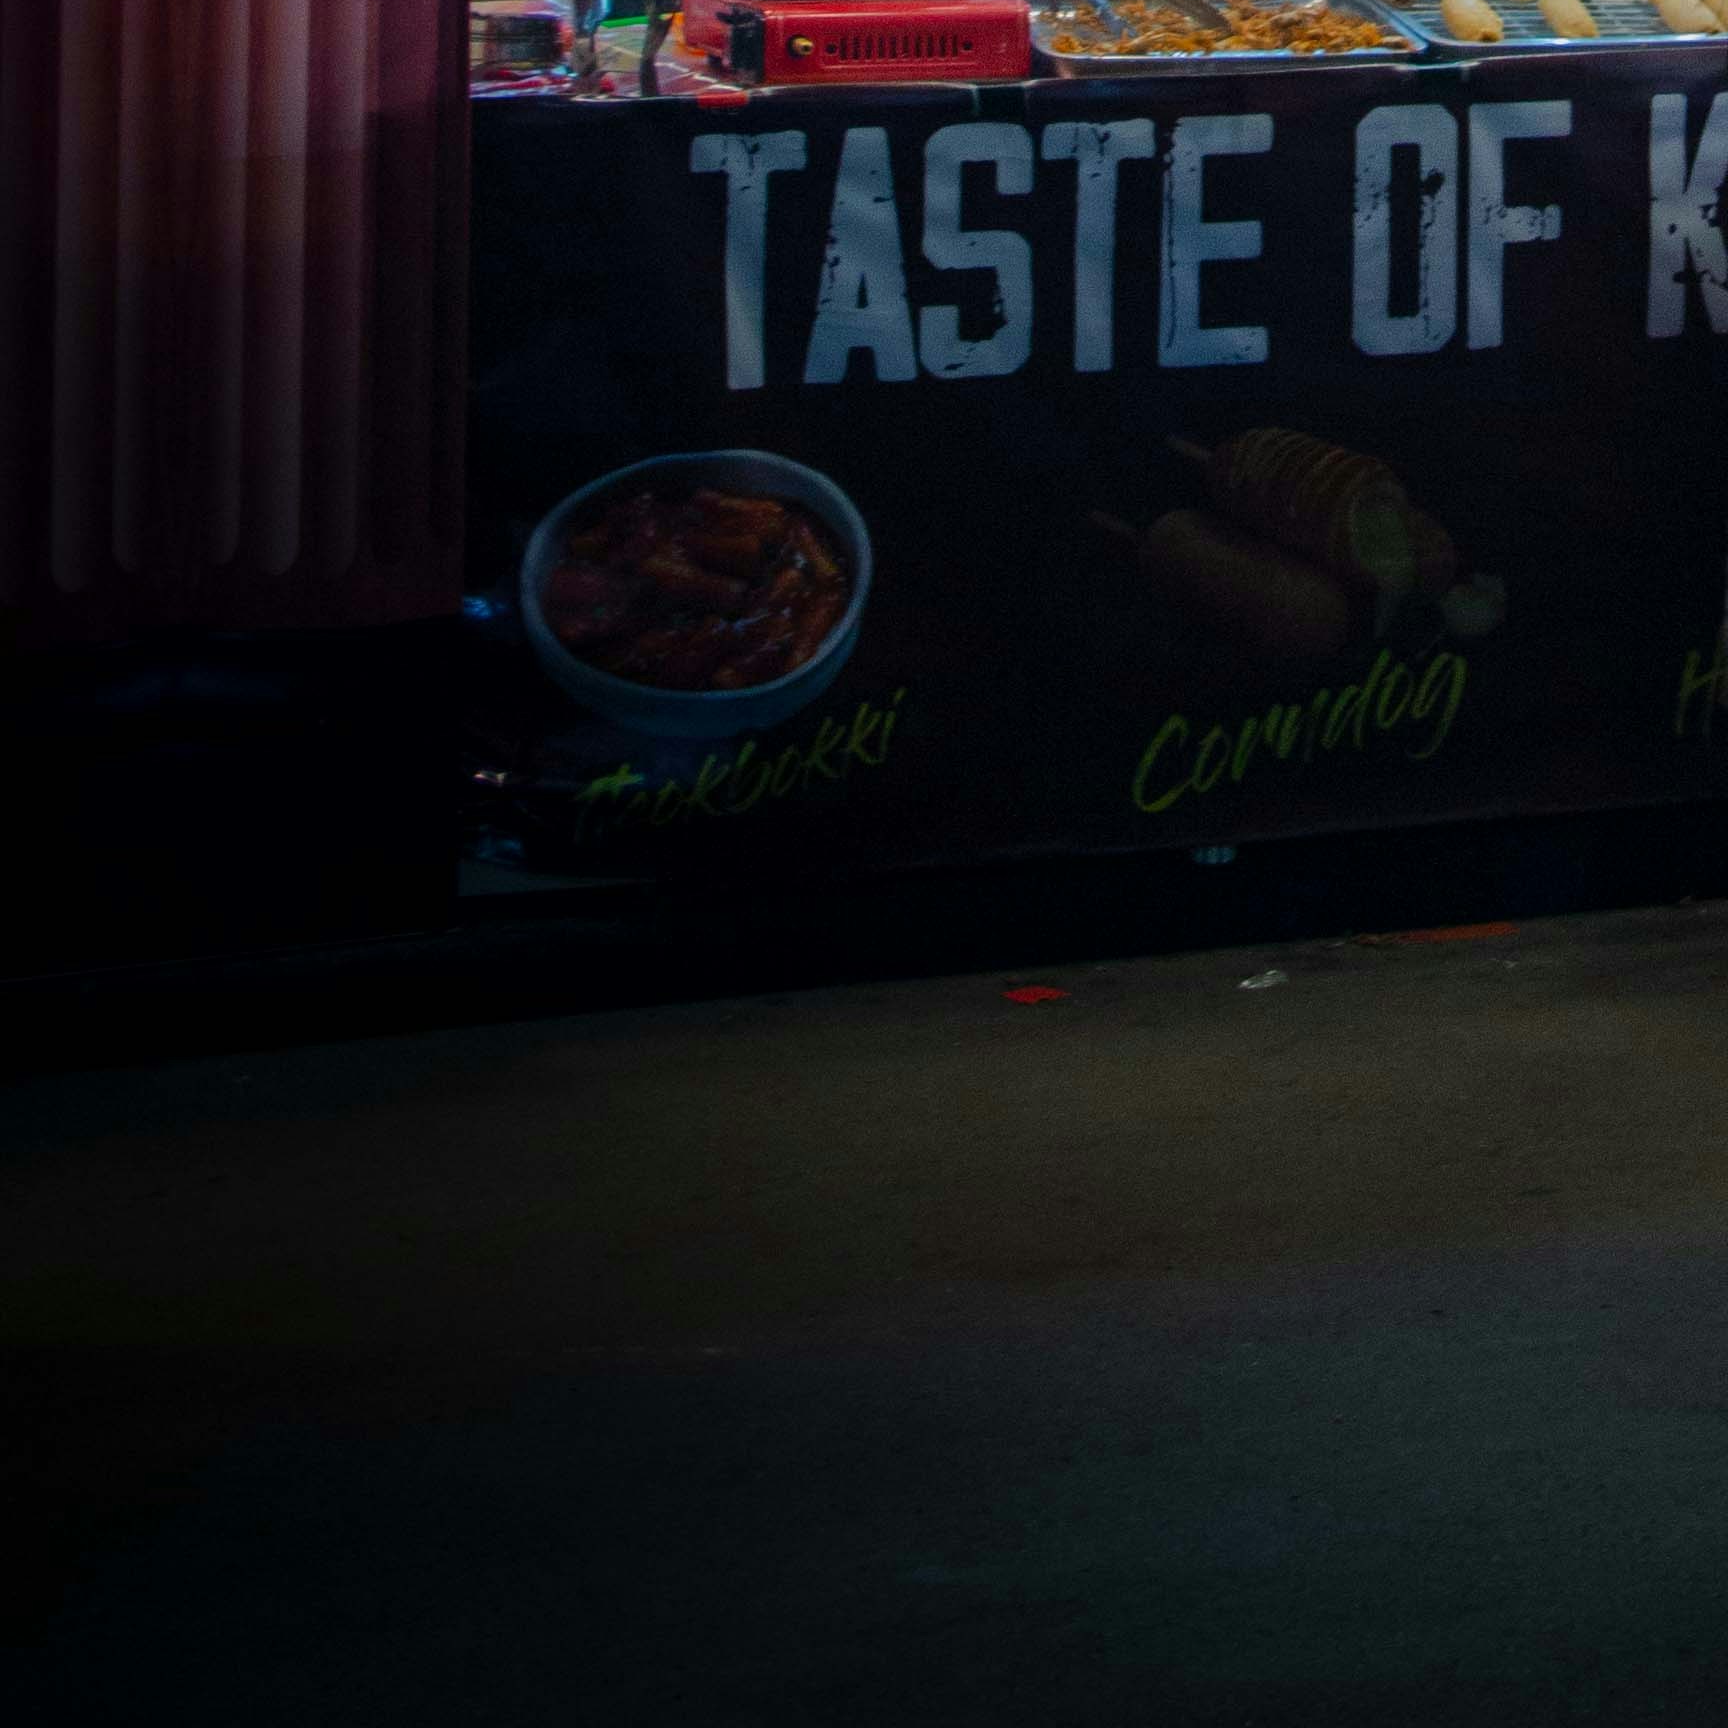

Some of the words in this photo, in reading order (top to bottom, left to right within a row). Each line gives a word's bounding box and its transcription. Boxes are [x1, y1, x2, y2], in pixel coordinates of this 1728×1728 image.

[689, 113, 1273, 391] TASTE
[1351, 100, 1572, 358] OF
[1130, 647, 1468, 815] Corndog
